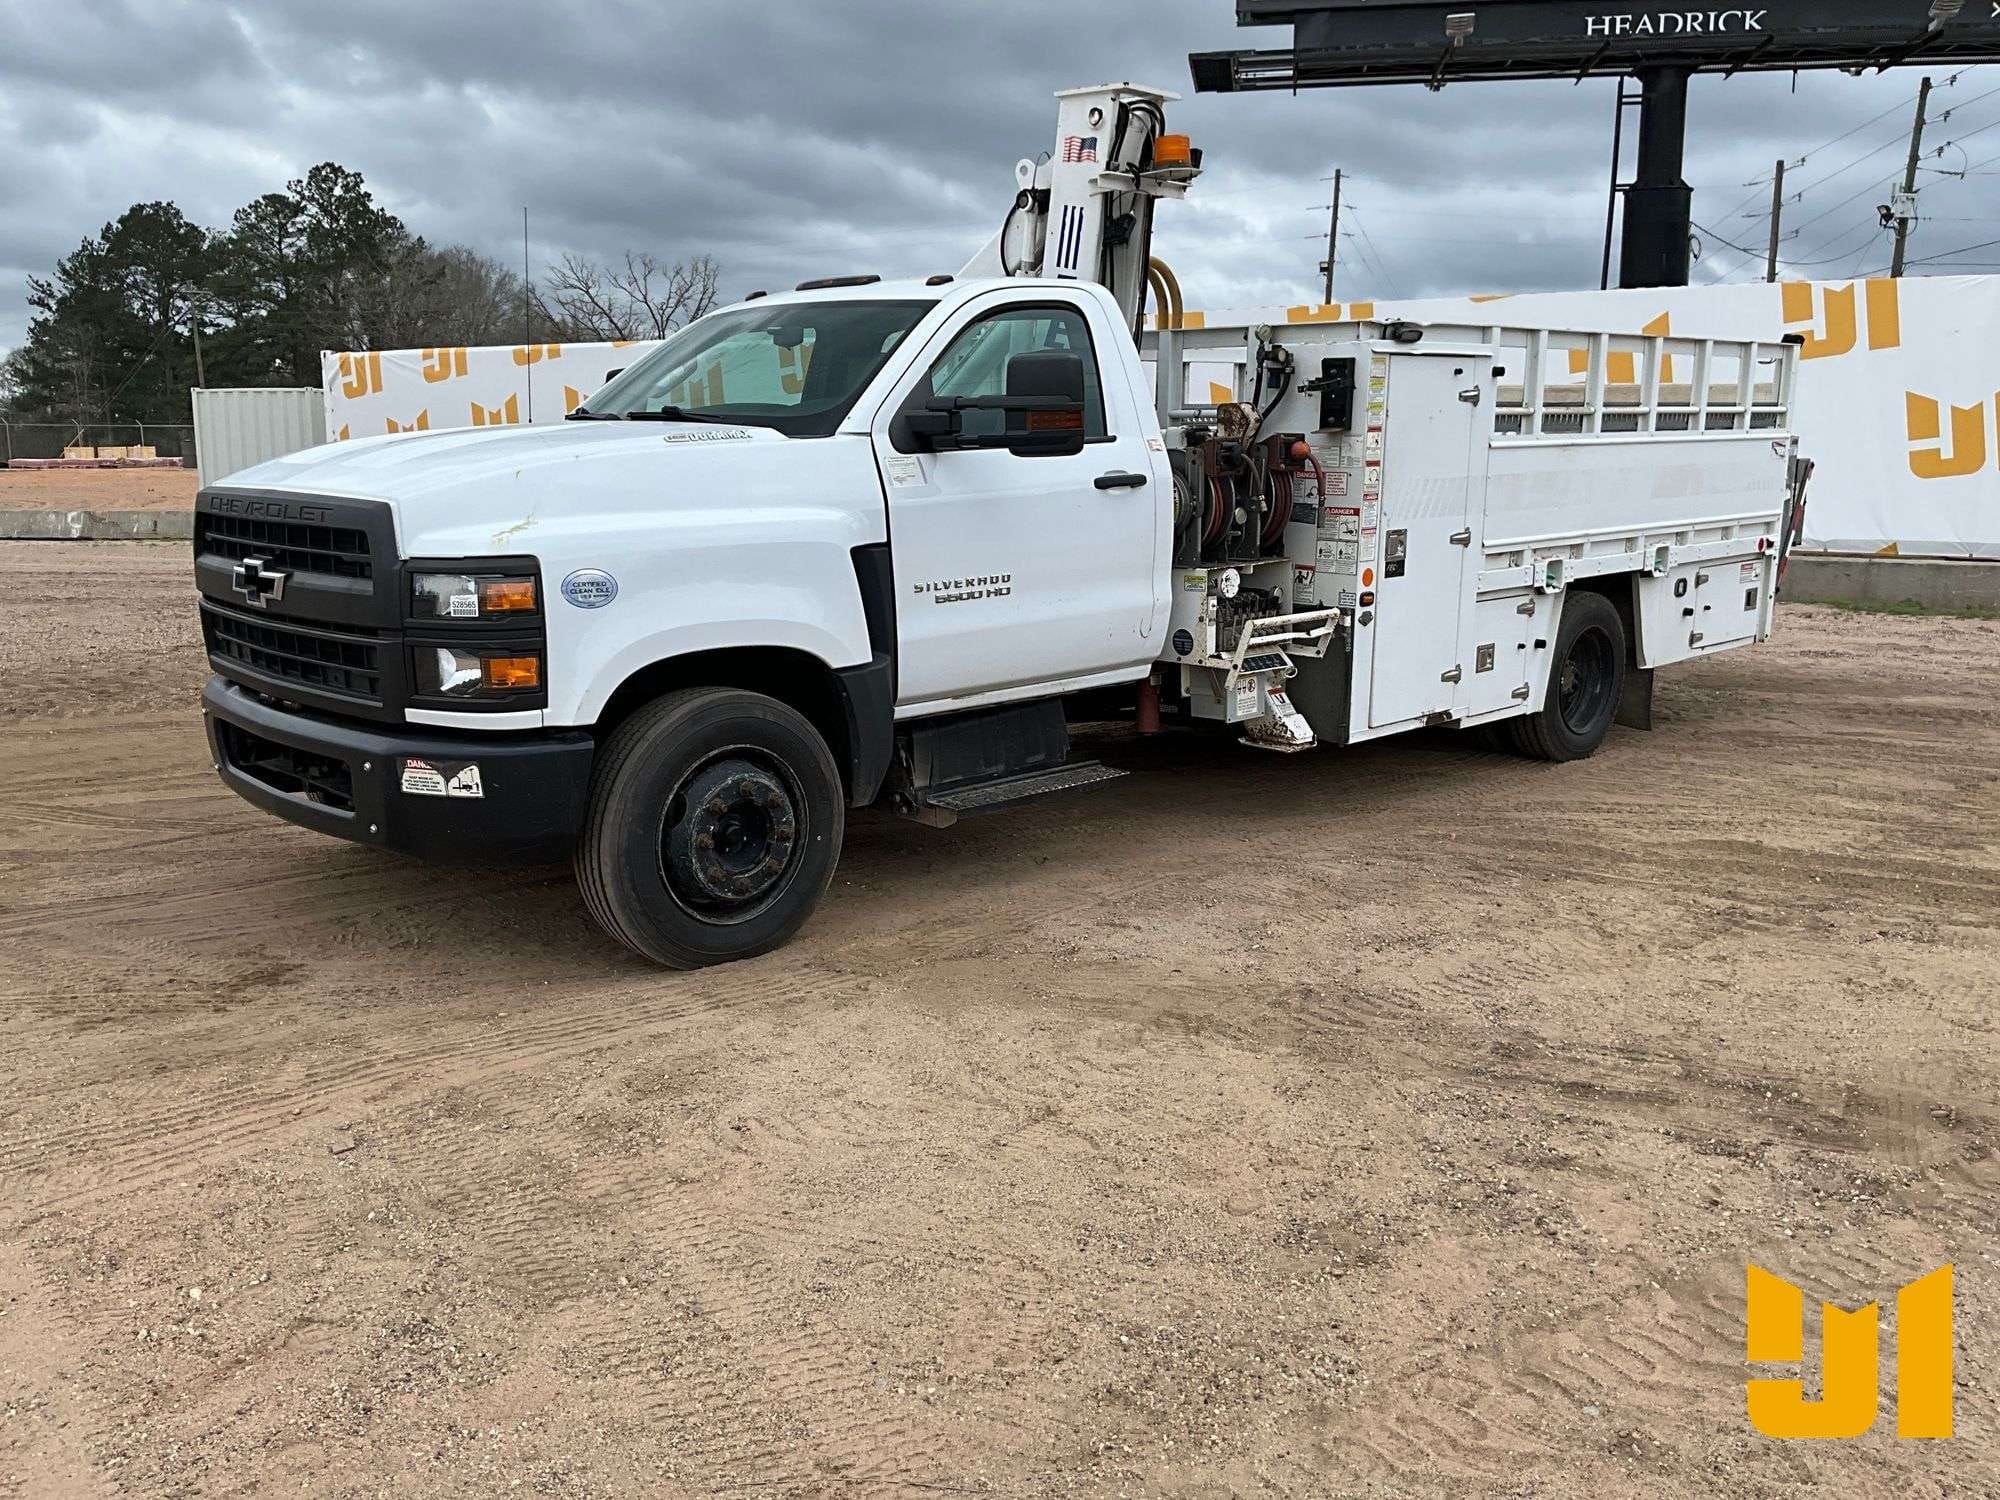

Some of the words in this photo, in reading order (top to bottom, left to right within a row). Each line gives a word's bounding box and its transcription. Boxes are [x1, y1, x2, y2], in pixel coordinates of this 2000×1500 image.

[1584, 10, 1767, 36] HEADRICK
[210, 496, 334, 522] CHEVROLET
[914, 574, 1011, 594] SILVERADO
[986, 587, 1011, 598] HD
